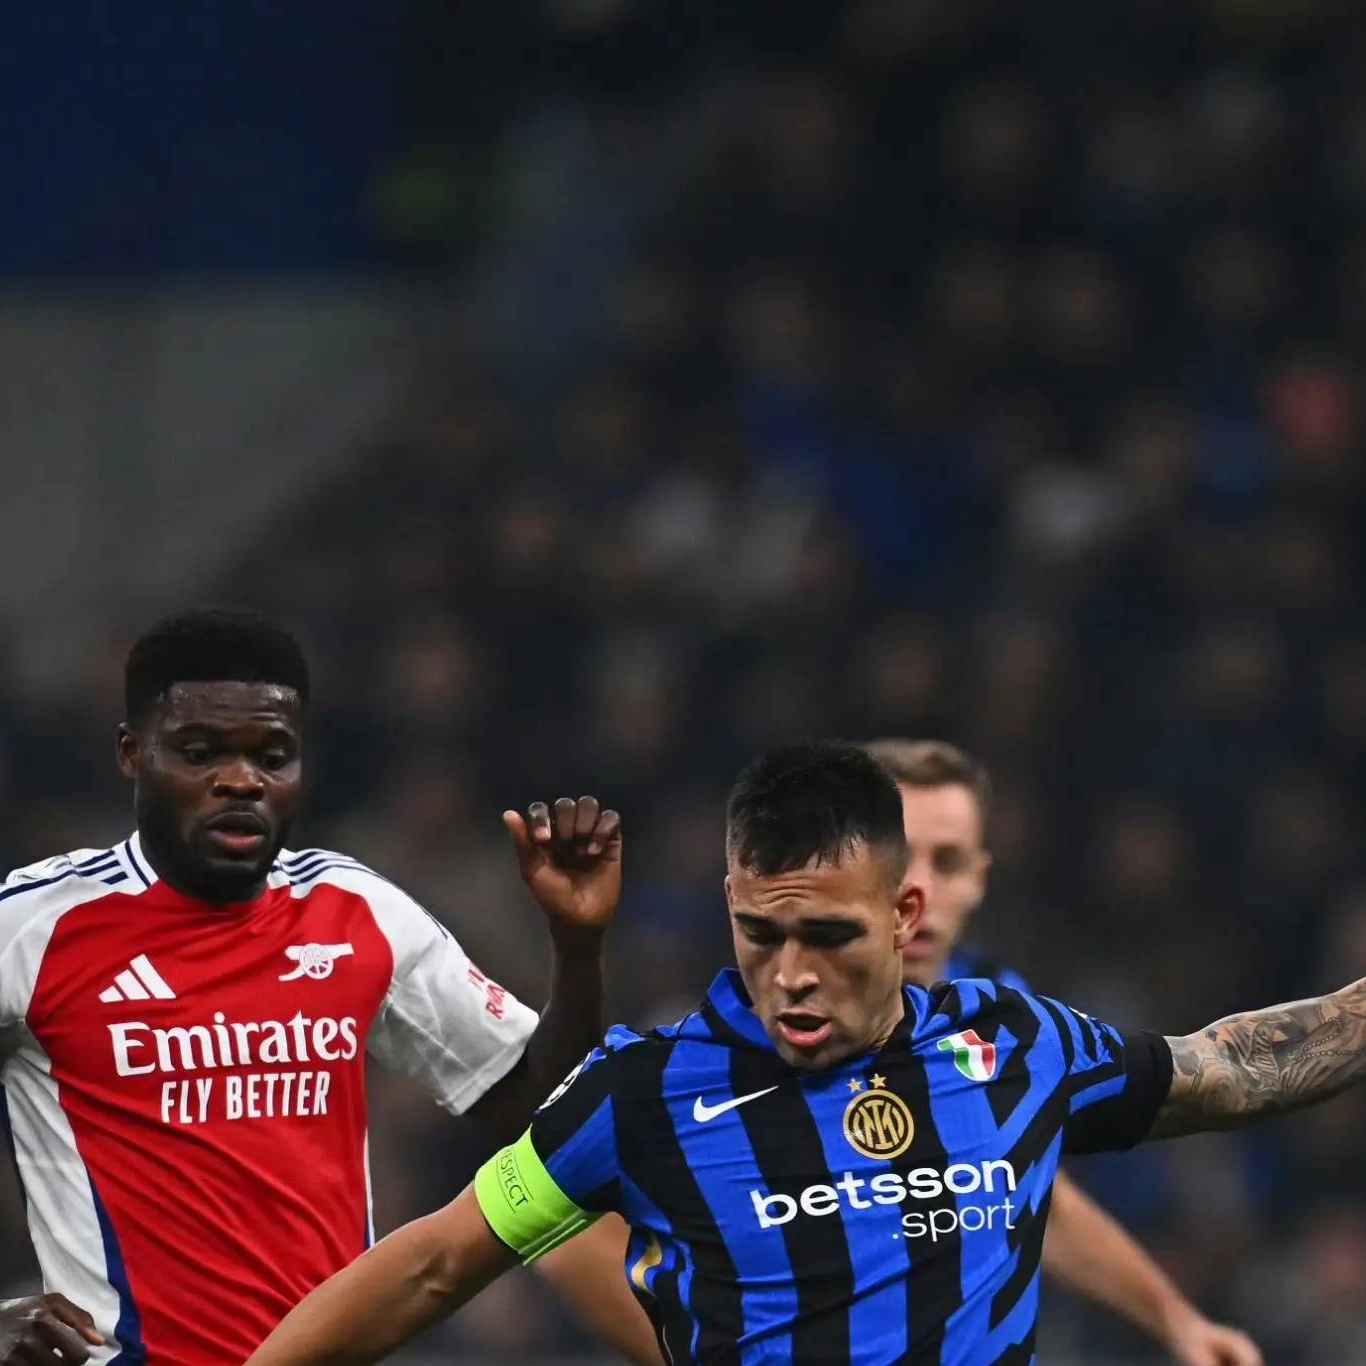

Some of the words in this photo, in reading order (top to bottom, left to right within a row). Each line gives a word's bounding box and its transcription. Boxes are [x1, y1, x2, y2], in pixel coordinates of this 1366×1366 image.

[106, 1010, 357, 1077] Emirates
[160, 1077, 213, 1124] FLY
[226, 1070, 331, 1120] BETTER
[749, 1158, 1017, 1229] betsson
[891, 1197, 1016, 1243] .sport
